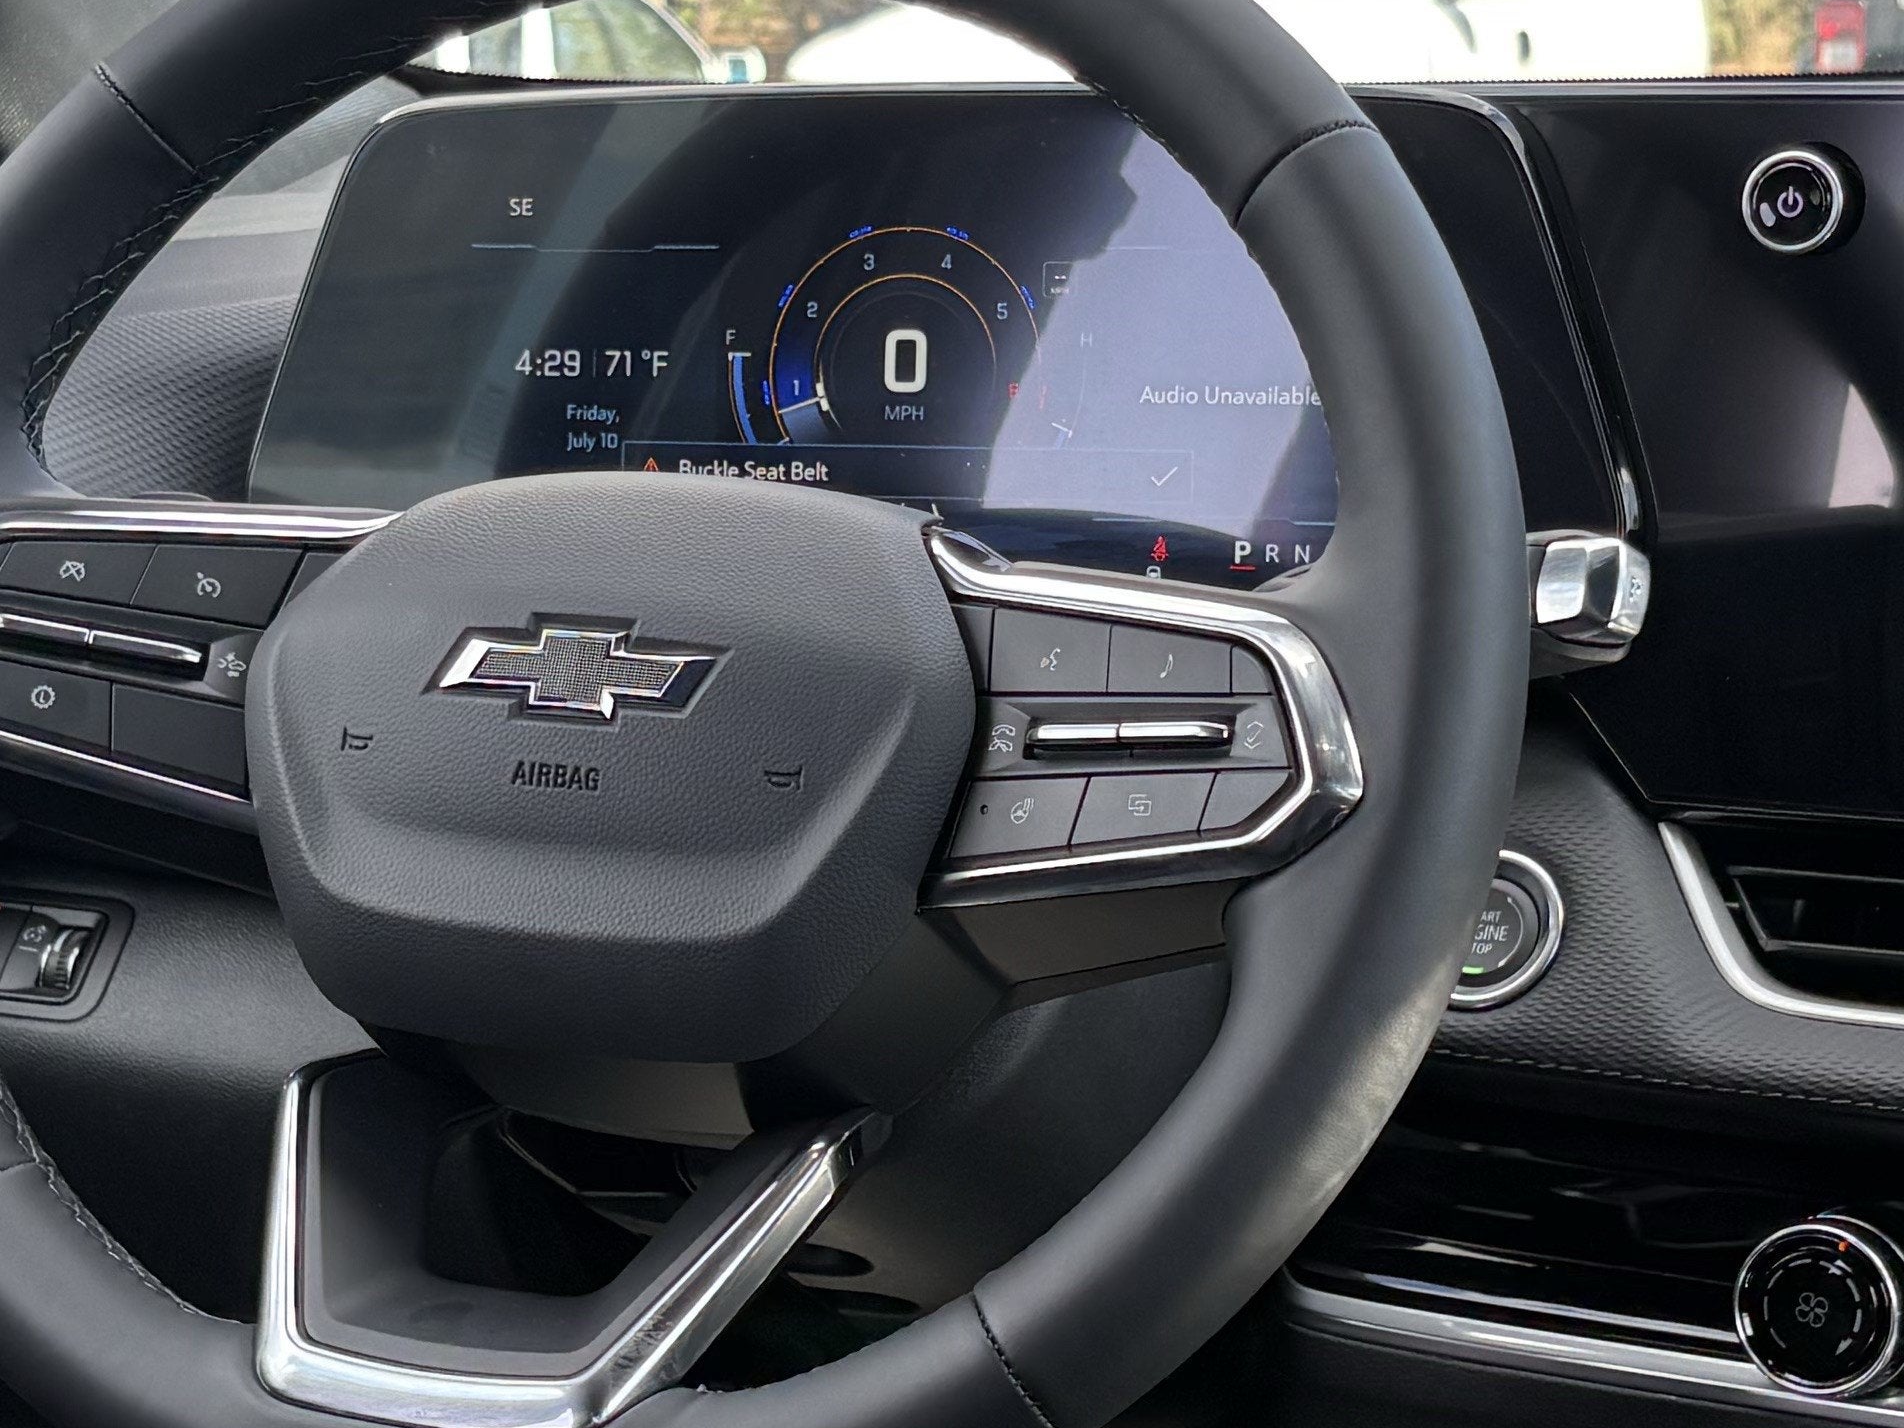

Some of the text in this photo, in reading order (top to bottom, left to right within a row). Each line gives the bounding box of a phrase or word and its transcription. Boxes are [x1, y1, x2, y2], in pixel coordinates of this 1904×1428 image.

[509, 197, 534, 217] SE
[863, 253, 952, 271] 3 4
[806, 301, 1008, 320] 2 5
[725, 329, 736, 346] F
[1080, 332, 1093, 348] H
[514, 348, 581, 377] 4:29
[604, 350, 632, 377] 71
[884, 328, 928, 393] 0
[793, 379, 800, 396] 1
[1139, 385, 1320, 405] Audio Unavailable
[566, 403, 620, 425] Friday,
[884, 405, 924, 421] MPH
[566, 431, 618, 453] July 10
[679, 458, 829, 482] Buckle Seat Belt
[1234, 540, 1311, 565] P R N
[510, 760, 601, 791] AIRBAG
[1480, 910, 1502, 923] ART
[1474, 923, 1509, 942] GINE
[1470, 942, 1493, 955] TOP
